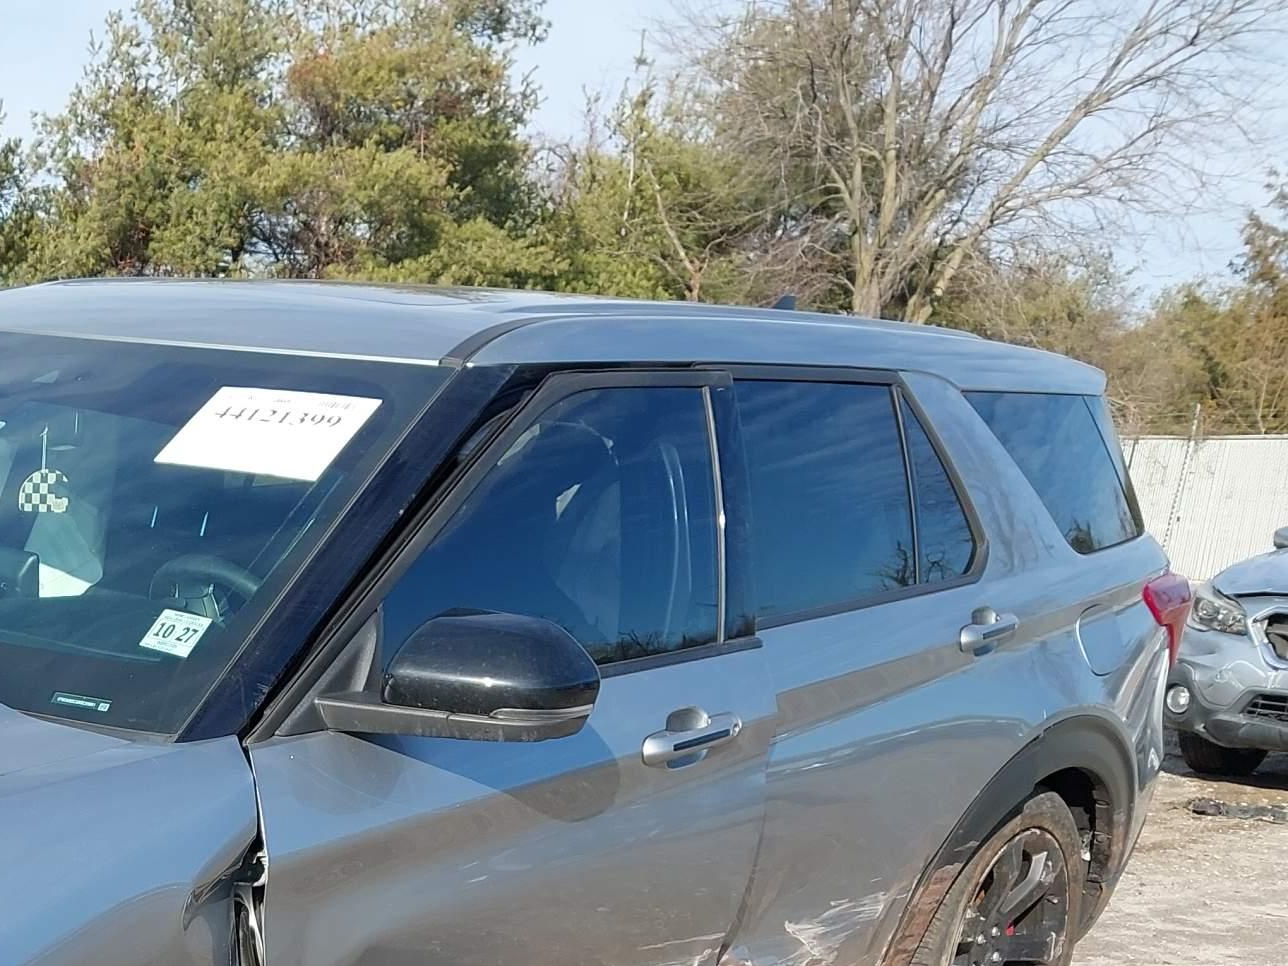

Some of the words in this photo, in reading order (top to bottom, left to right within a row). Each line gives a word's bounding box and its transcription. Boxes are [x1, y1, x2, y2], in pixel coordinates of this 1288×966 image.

[214, 405, 343, 428] 44121399
[153, 621, 176, 639] 10
[175, 626, 200, 643] 27
